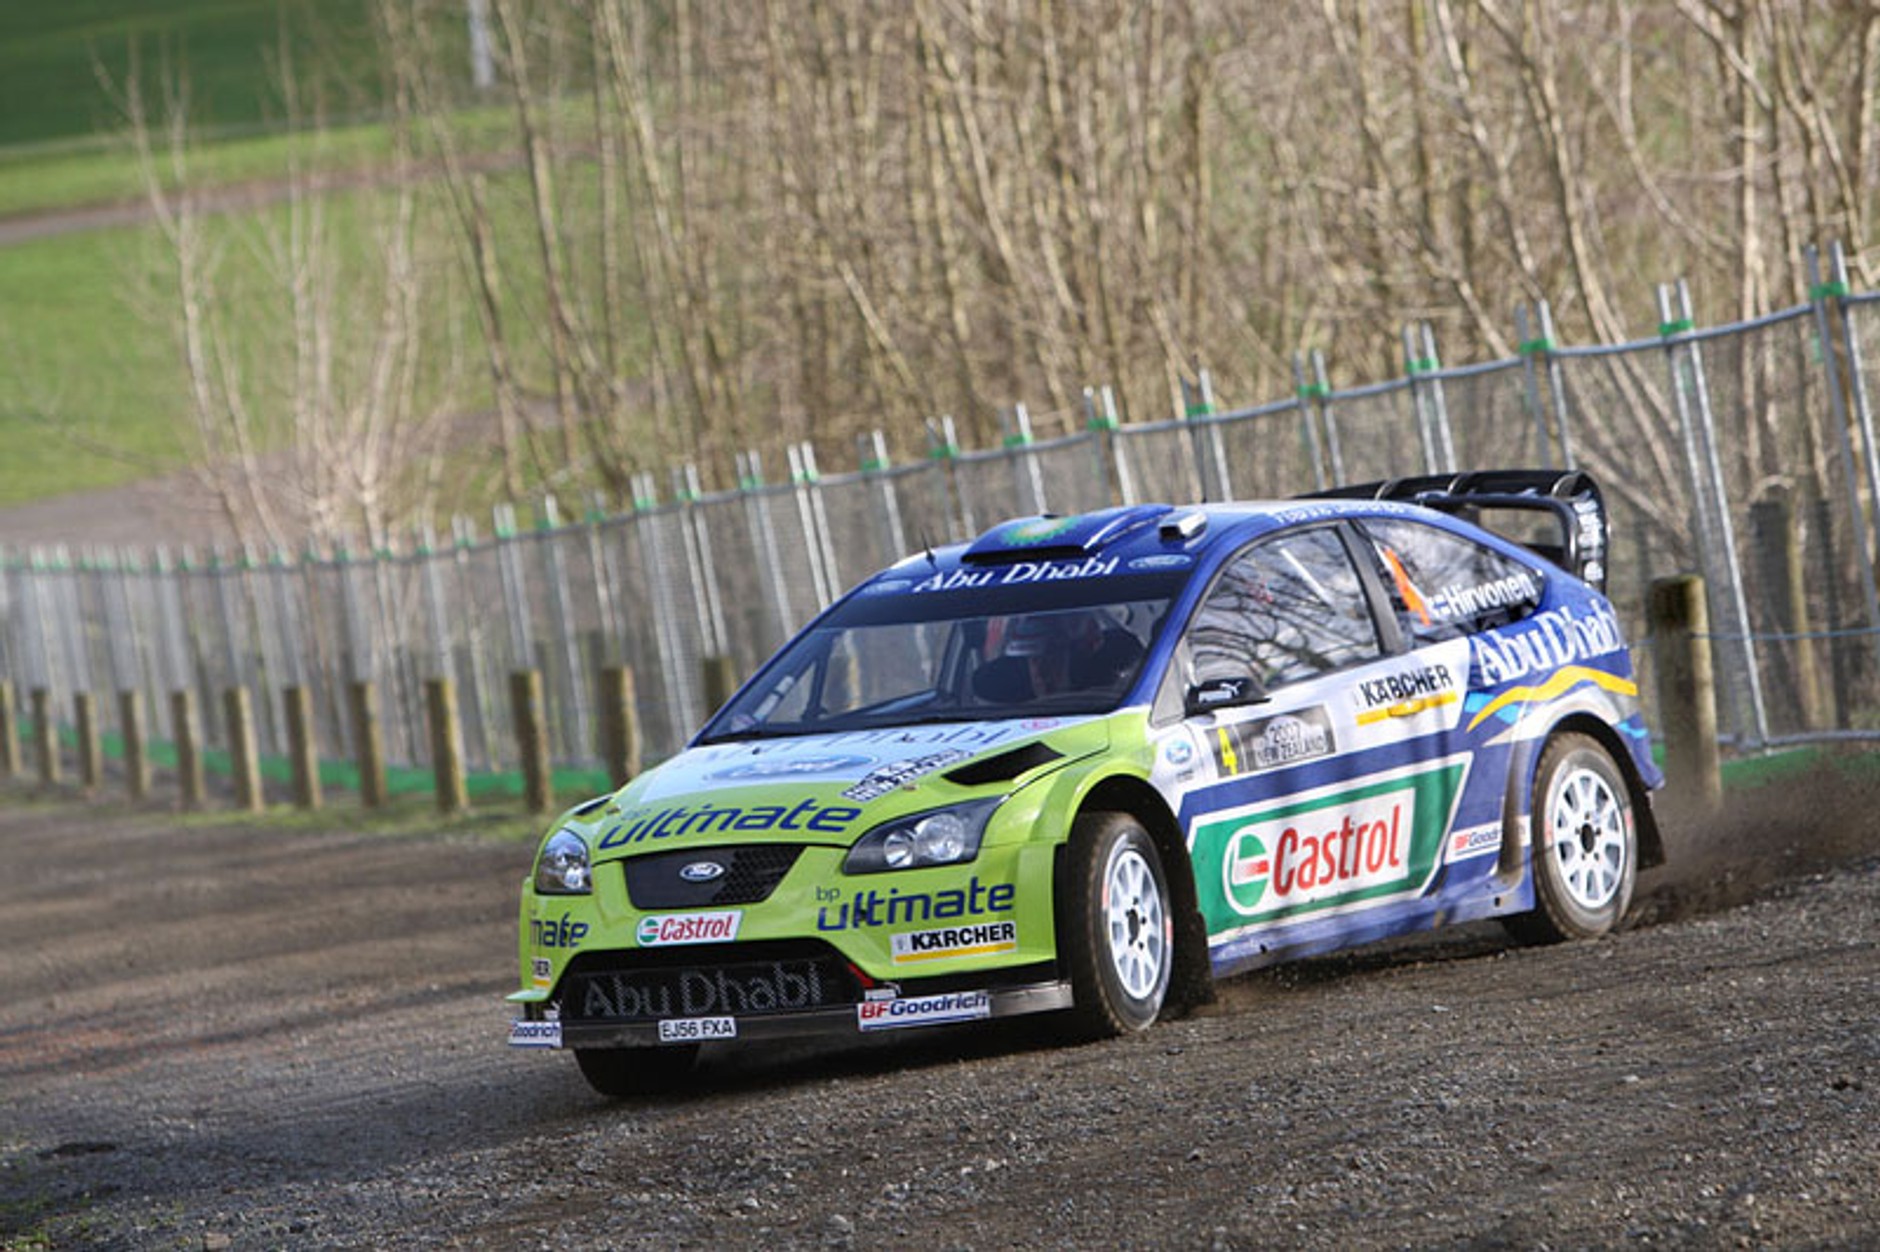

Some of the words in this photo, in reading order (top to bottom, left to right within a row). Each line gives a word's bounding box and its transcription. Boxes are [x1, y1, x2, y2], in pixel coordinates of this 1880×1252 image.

[913, 570, 993, 593] Abu
[1442, 573, 1536, 616] Hirvonen
[1469, 630, 1552, 686] Abu
[1217, 727, 1238, 776] 4
[599, 799, 862, 849] ultimate
[1273, 804, 1400, 897] Castrol
[816, 886, 840, 901] bp
[817, 877, 1015, 931] ultimate
[660, 914, 733, 941] Castrol
[912, 922, 1015, 951] KÄRCHER
[583, 974, 673, 1016] Abu
[861, 995, 987, 1018] BFGoodrich
[662, 1020, 698, 1038] EJ56
[702, 1018, 734, 1036] FXA
